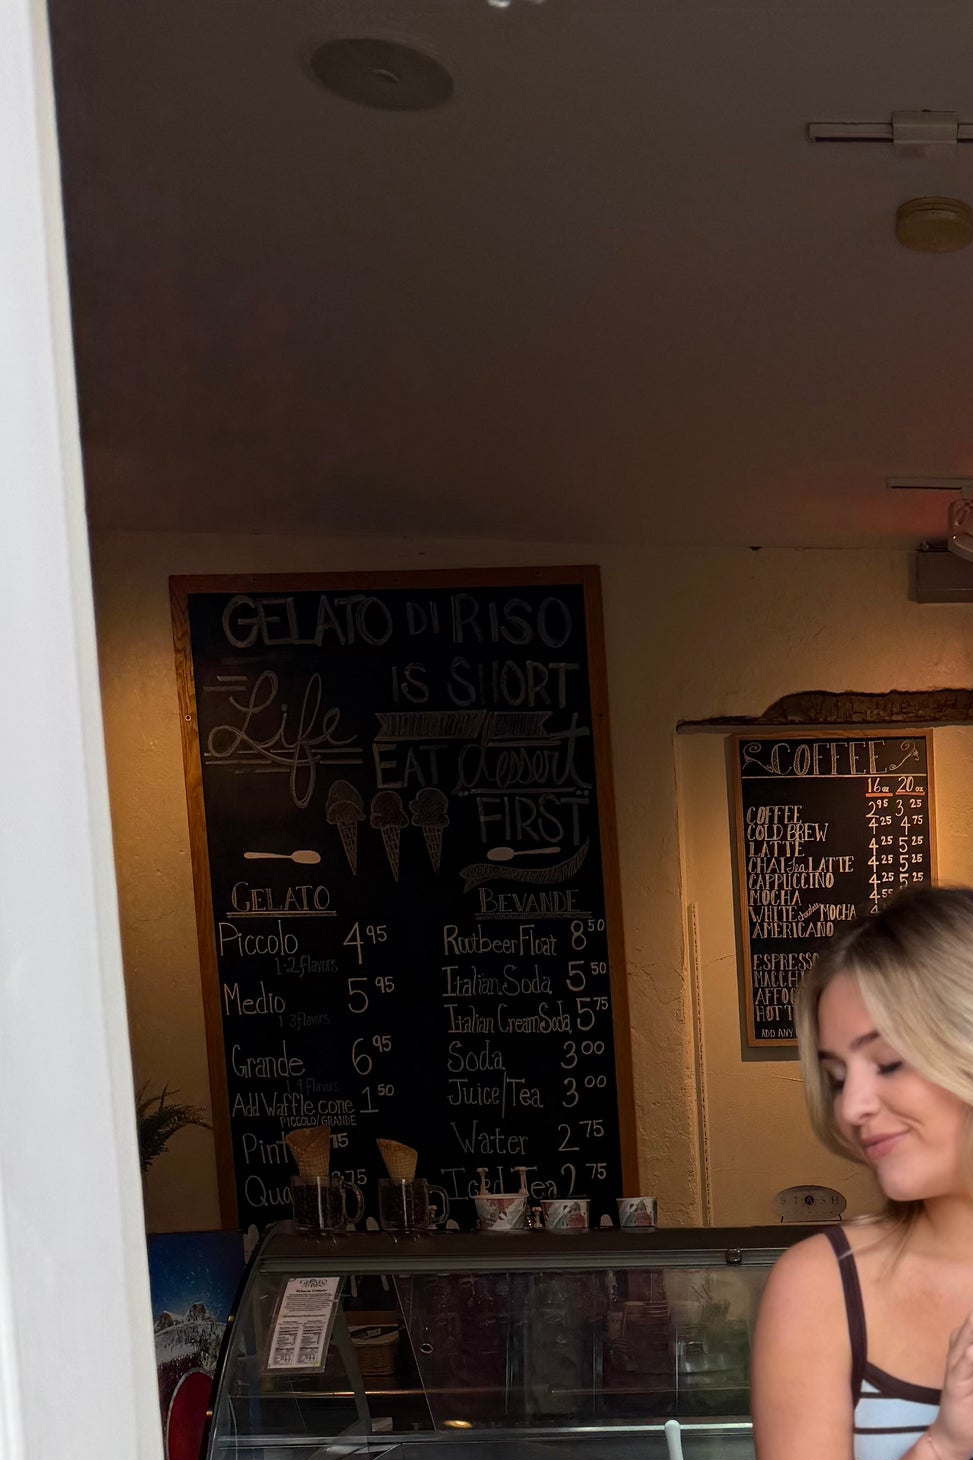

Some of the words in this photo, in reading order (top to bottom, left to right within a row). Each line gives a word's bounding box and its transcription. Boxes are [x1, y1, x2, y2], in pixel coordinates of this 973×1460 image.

[221, 595, 393, 649] GELATO
[404, 599, 438, 636] DI
[449, 592, 572, 649] RISO
[390, 662, 430, 704] IS
[445, 655, 580, 710] SHORT
[207, 669, 357, 808] Life
[371, 742, 450, 789] EAT
[453, 711, 591, 793] dessert
[770, 740, 888, 776] COFFEE
[475, 793, 589, 849] FIRST
[746, 804, 803, 825] COFFEE
[747, 824, 784, 841] COLD
[787, 823, 829, 842] BREW
[748, 841, 805, 858] LATTE
[748, 857, 786, 874] CHAI
[807, 855, 854, 873] LATTE
[230, 881, 330, 912] GELATO
[748, 871, 834, 891] CAPPUCCINO
[748, 889, 802, 906] MOCHA
[477, 886, 581, 914] BEVANDE
[749, 905, 798, 923] WHITE
[819, 903, 857, 922] MOCHA
[218, 920, 299, 957] Piccolo
[518, 923, 559, 957] Float
[752, 921, 835, 939] AMERICANO
[441, 965, 500, 997] Italian
[501, 964, 552, 996] Soda
[223, 980, 286, 1016] Medio
[755, 1004, 782, 1022] HOT
[443, 1003, 495, 1034] Italian
[496, 1002, 540, 1034] Cream
[760, 1028, 779, 1038] ADD
[780, 1027, 798, 1038] ANY
[231, 1040, 306, 1079] Grande
[448, 1039, 505, 1073] Soda
[231, 1092, 259, 1117] Add
[259, 1091, 315, 1117] Waffle
[316, 1099, 355, 1115] cone
[242, 1131, 288, 1165] Pint
[449, 1119, 528, 1155] Water
[245, 1175, 294, 1208] Qua
